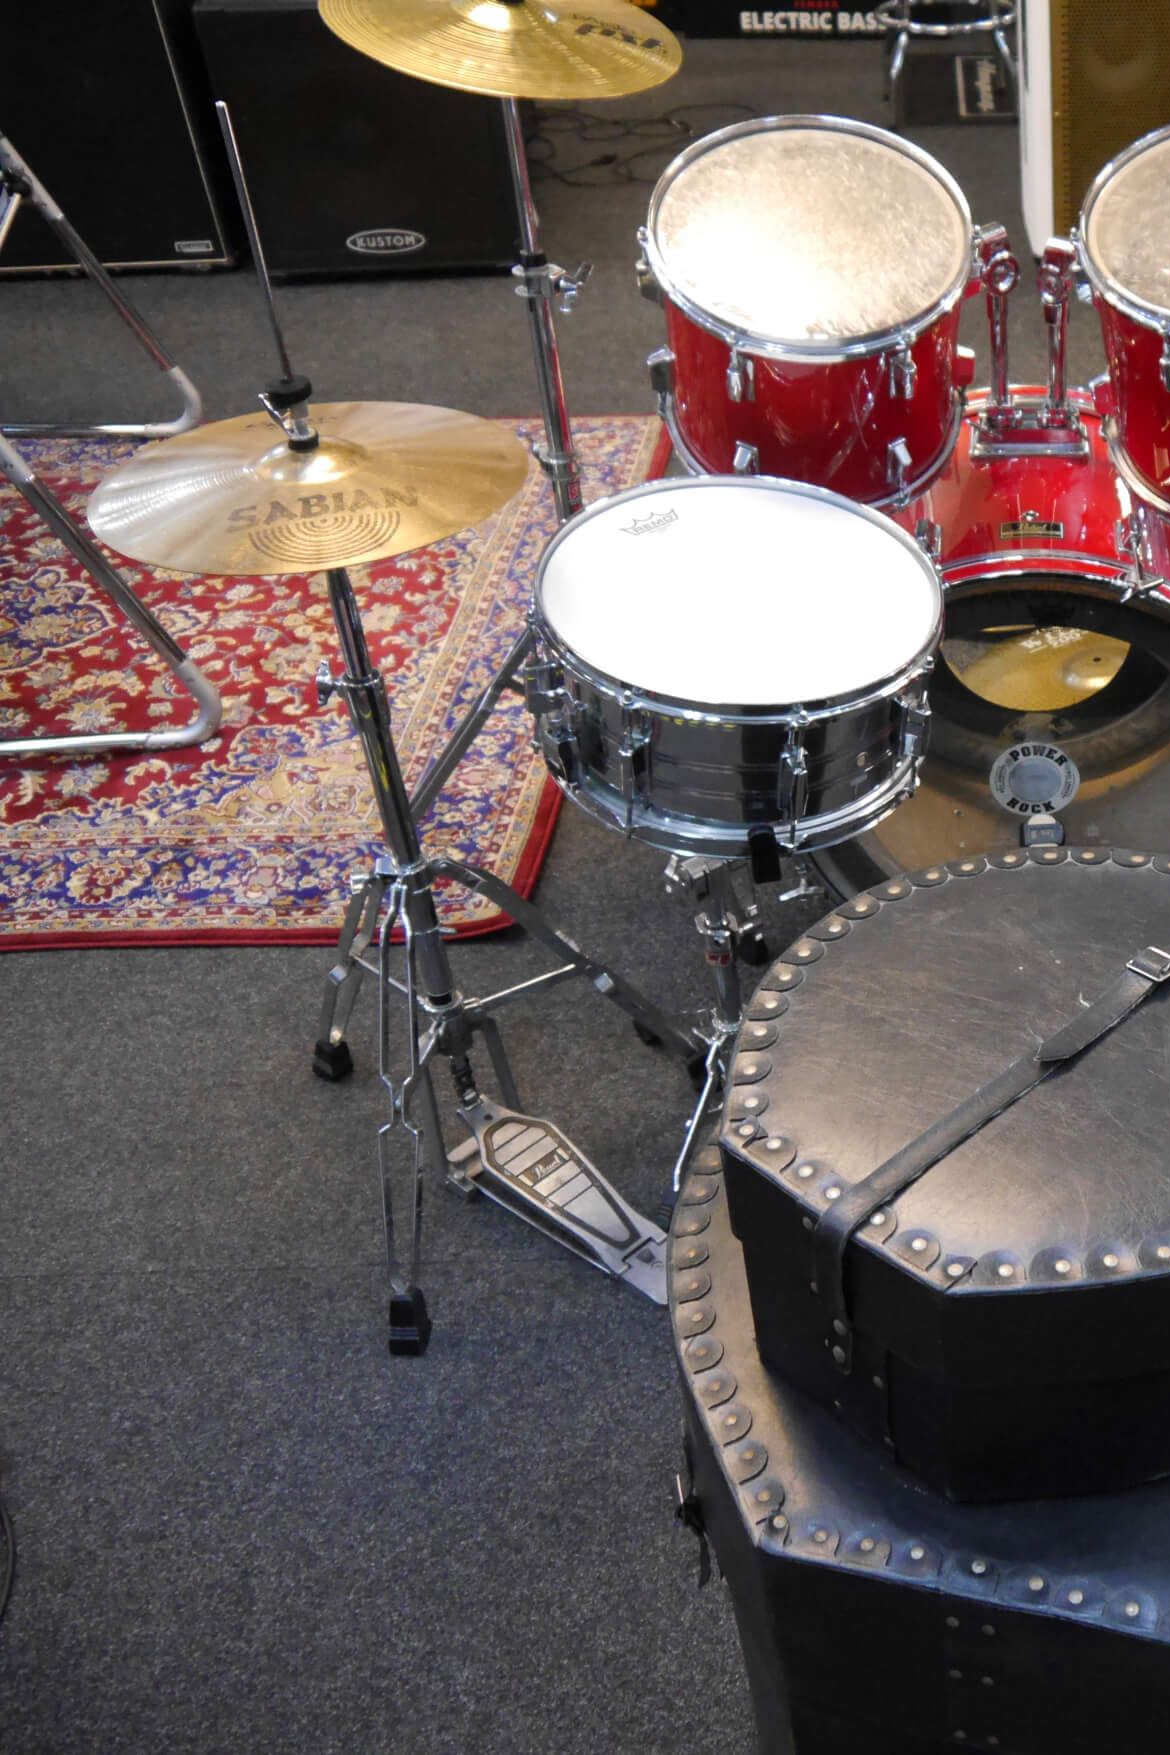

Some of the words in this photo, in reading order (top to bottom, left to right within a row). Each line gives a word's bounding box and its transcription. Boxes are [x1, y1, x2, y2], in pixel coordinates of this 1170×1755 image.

[740, 11, 833, 31] ELECTRIC
[355, 234, 417, 249] KUSTOM
[225, 486, 419, 533] SABIAN
[1008, 745, 1068, 767] POWER
[1006, 796, 1057, 814] ROCK
